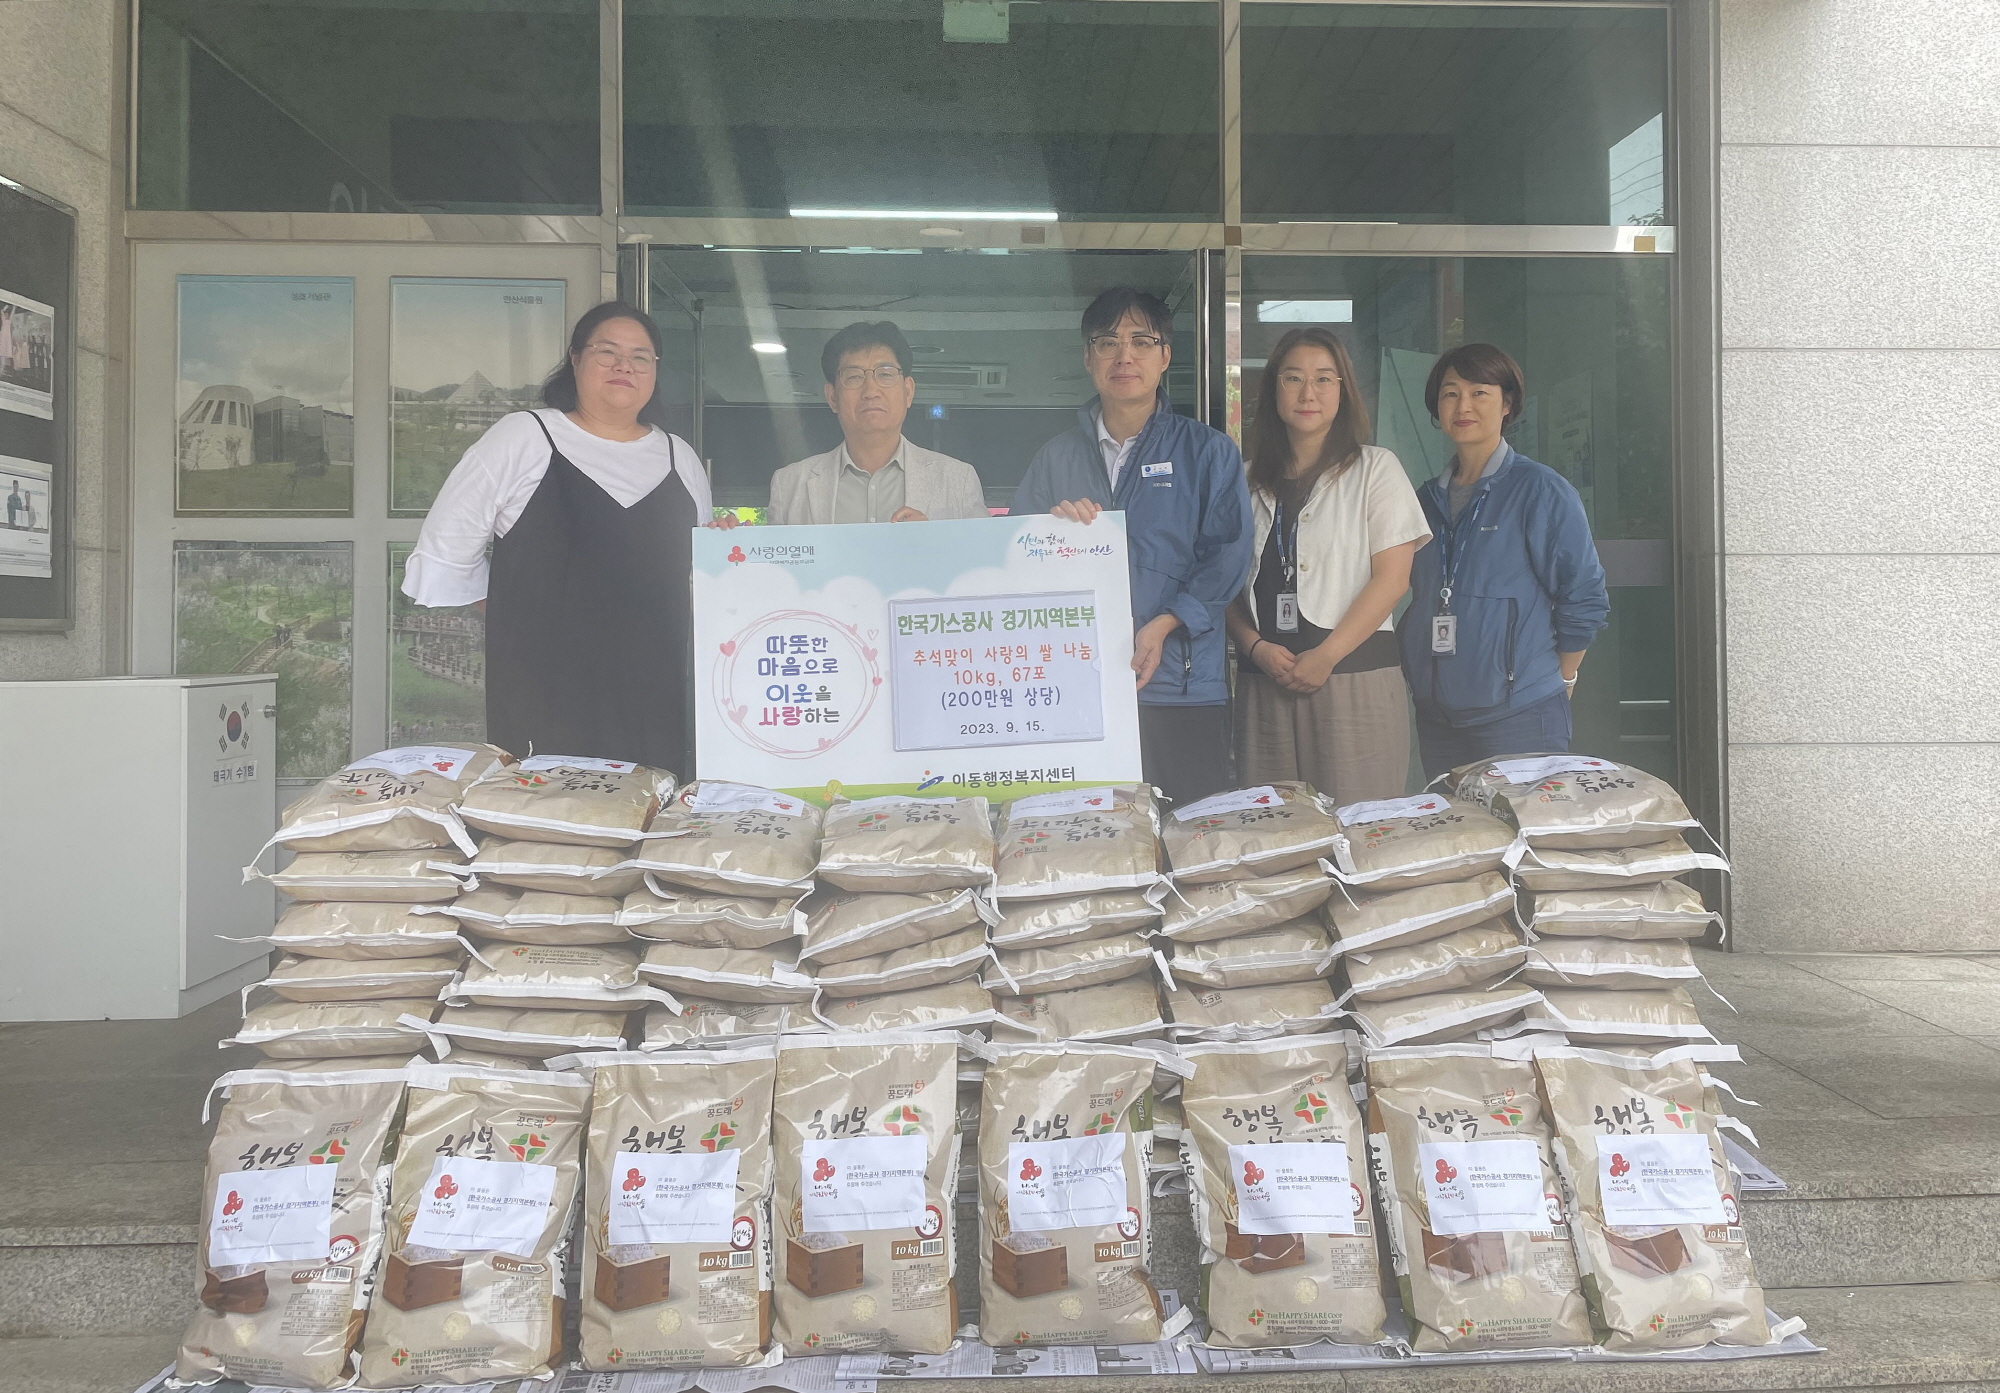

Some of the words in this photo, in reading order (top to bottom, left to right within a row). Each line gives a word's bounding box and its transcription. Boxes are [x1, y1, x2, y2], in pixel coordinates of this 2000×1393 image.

[749, 545, 814, 559] 사랑의열매
[1089, 544, 1114, 556] 안산
[897, 610, 993, 636] 한국가스공사
[1001, 605, 1096, 631] 경기지역본부
[766, 634, 829, 655] 따뜻한
[913, 647, 973, 667] 추석맞이
[984, 644, 1029, 665] 사랑의
[1039, 643, 1053, 662] 쌀
[1063, 642, 1093, 661] 나눔
[757, 656, 839, 676] 마음으로
[954, 669, 1003, 687] 10kg,
[1012, 665, 1046, 683] 67포
[766, 683, 832, 704] 이웃을
[941, 688, 1014, 711] (200만원
[1024, 685, 1061, 707] 상당)
[758, 705, 840, 726] 사랑하는
[960, 723, 999, 735] 2023.
[1006, 721, 1019, 734] 9.
[1026, 720, 1045, 733] 15.
[952, 766, 1076, 789] 이동행정복지센터
[887, 1088, 913, 1100] 꿈드래
[1089, 1098, 1113, 1109] 꿈드래
[707, 1106, 733, 1118] 꿈드래
[1594, 1097, 1655, 1135] 행복
[1222, 1104, 1284, 1136] 행복
[1417, 1105, 1479, 1139] 행복
[1707, 1229, 1717, 1238] 10
[1717, 1228, 1727, 1241] kg
[896, 1246, 906, 1255] 10
[907, 1244, 919, 1256] kg
[1099, 1249, 1109, 1257] 10
[1111, 1246, 1121, 1258] kg
[703, 1256, 715, 1267] 10
[716, 1255, 728, 1268] kg
[295, 1270, 308, 1279] 10
[309, 1269, 322, 1280] kg
[1678, 1314, 1699, 1322] HAPPY
[834, 1333, 858, 1341] HAPPY
[424, 1348, 451, 1357] HAPPY
[452, 1346, 477, 1354] SHARE
